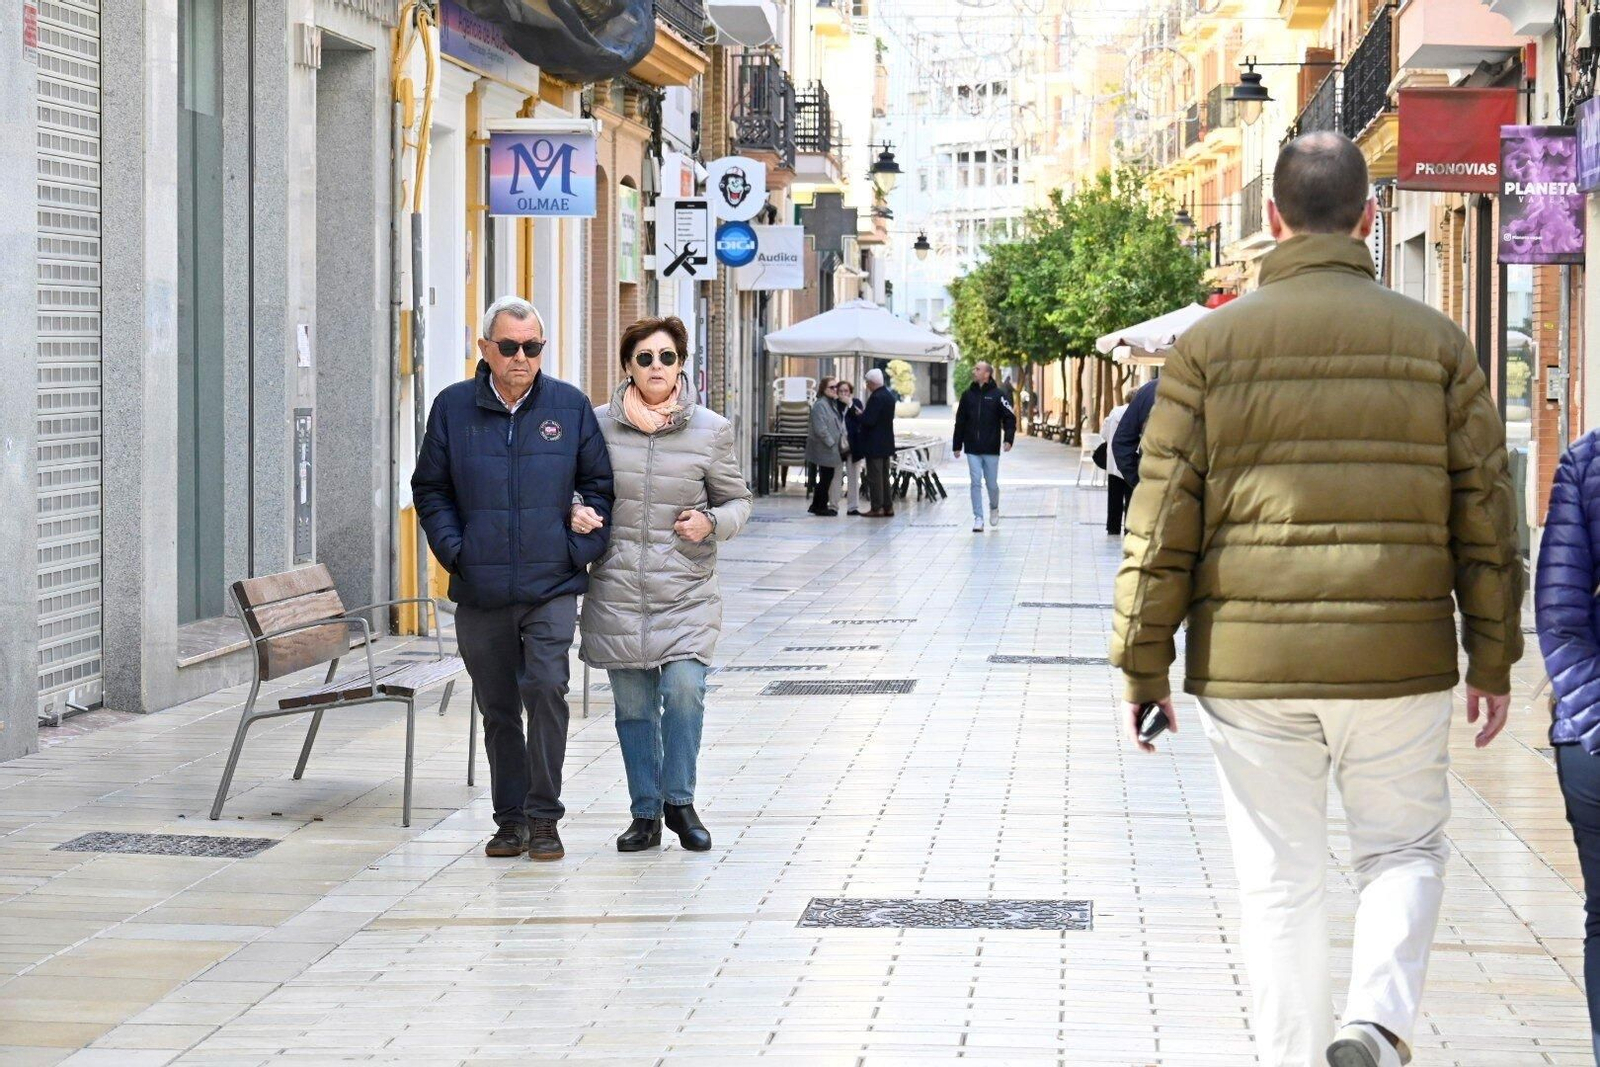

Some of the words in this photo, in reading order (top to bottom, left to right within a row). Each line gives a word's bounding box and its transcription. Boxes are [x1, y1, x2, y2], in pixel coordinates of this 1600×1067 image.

[1415, 162, 1497, 176] PRONOVIAS
[1504, 181, 1579, 195] PLANETA
[517, 197, 570, 211] OLMAE
[717, 240, 755, 250] DIGI
[757, 252, 798, 262] Audika
